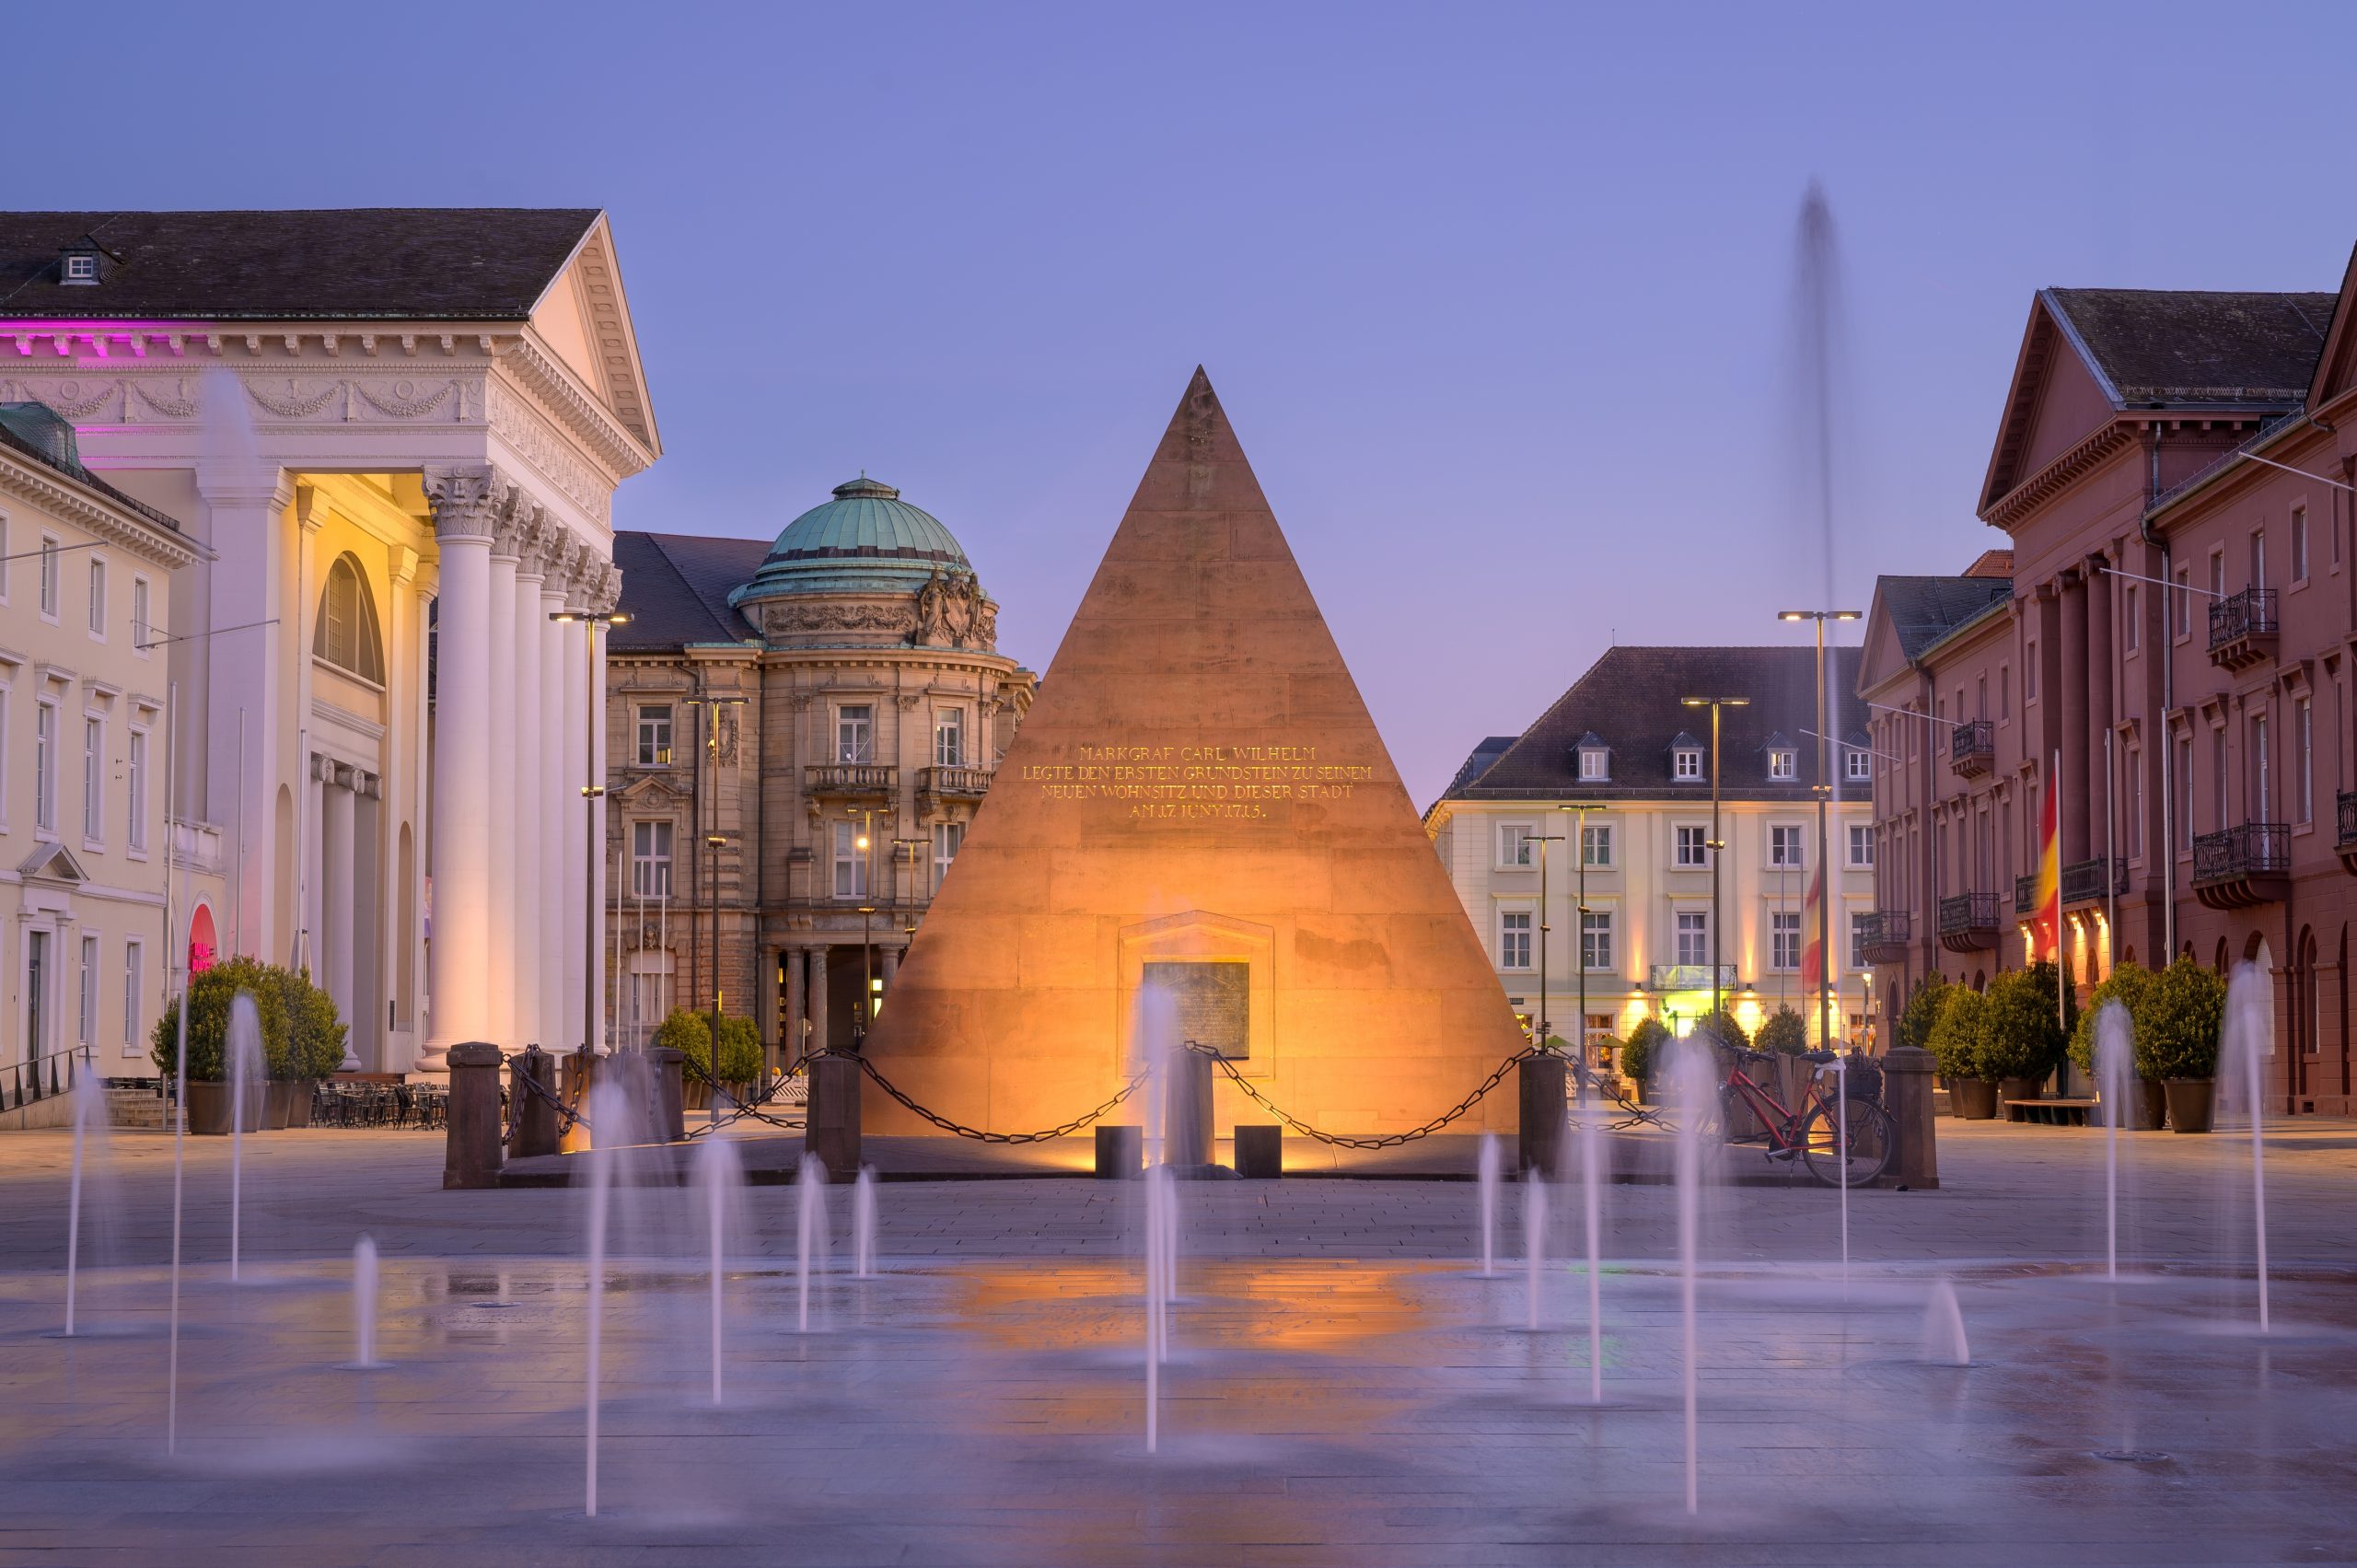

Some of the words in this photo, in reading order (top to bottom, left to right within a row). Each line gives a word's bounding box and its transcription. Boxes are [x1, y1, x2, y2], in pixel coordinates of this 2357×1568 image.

[1079, 747, 1174, 761] MARKGRAF
[1180, 747, 1227, 761] CARL
[1233, 747, 1317, 761] WILHELM
[1023, 766, 1074, 780] LEGTE
[1078, 766, 1109, 780] DEN
[1114, 766, 1179, 780] ERSTEN
[1183, 766, 1288, 780] GRUNDSTEIN
[1292, 766, 1313, 780] ZU
[1316, 766, 1372, 780] SEINEM
[1041, 785, 1097, 799] NEUEN
[1100, 785, 1187, 799] WOHNSITZ
[1191, 785, 1228, 799] UND
[1235, 785, 1293, 799] DIESER
[1297, 784, 1354, 799] STADT
[1129, 805, 1155, 819] AM
